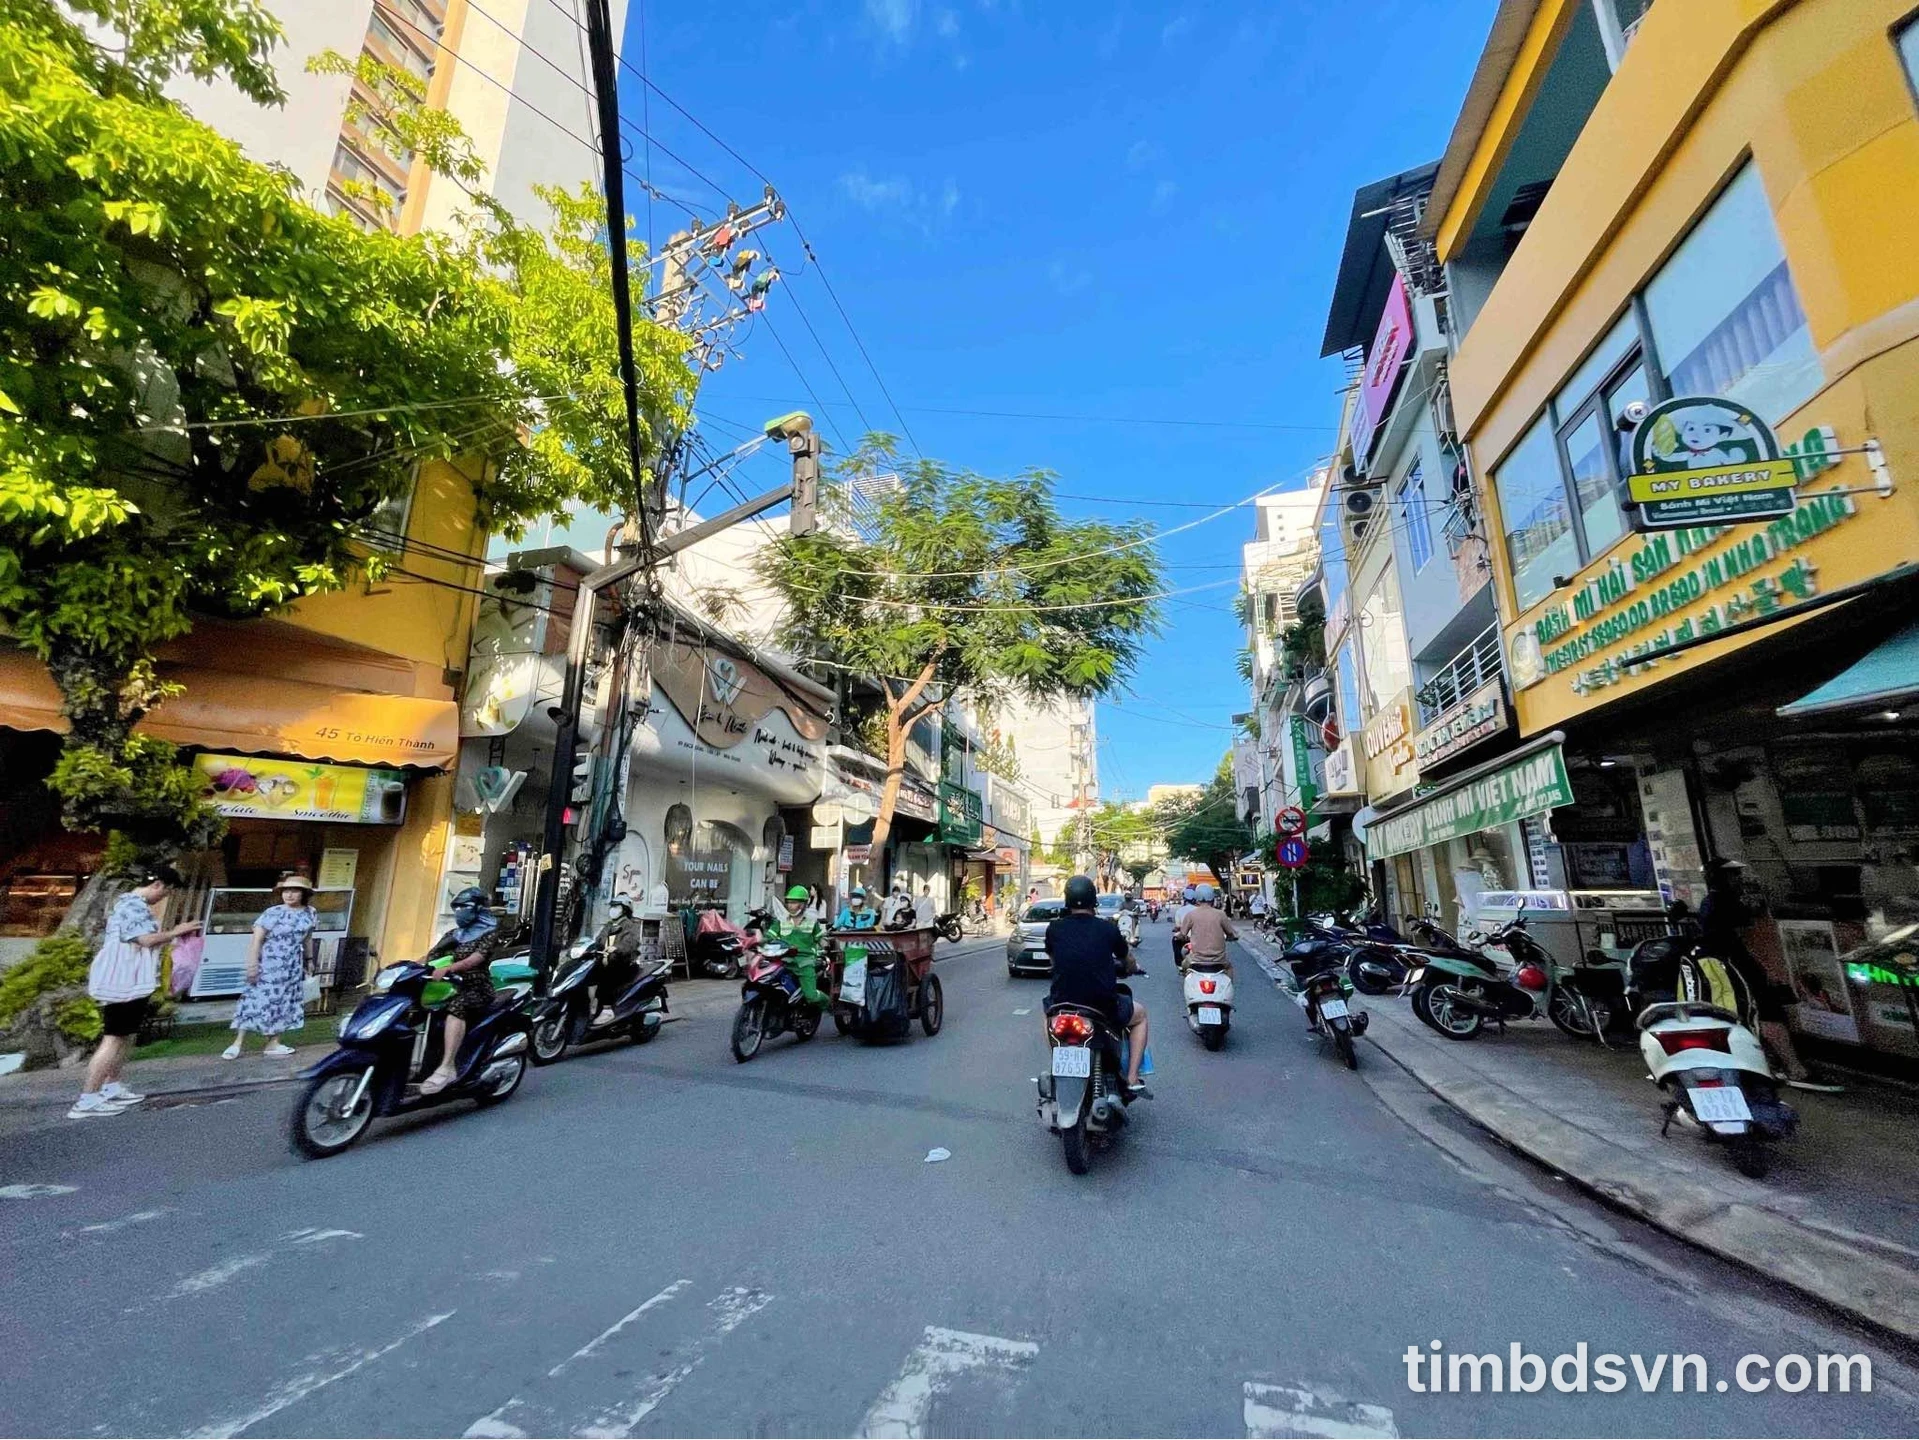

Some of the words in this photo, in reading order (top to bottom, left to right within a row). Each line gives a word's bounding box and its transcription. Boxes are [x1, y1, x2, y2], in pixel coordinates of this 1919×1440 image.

[1651, 480, 1680, 493] MY
[1688, 470, 1771, 489] BAKERY
[1597, 557, 1628, 608] HẢI
[315, 727, 342, 740] 45
[399, 737, 436, 751] Thành
[1366, 705, 1405, 761] OUVENIR
[1511, 752, 1558, 800] NAM
[292, 808, 352, 819] Smoothie
[684, 861, 704, 872] YOUR
[707, 862, 728, 872] NAILS
[690, 878, 707, 889] CAN
[709, 879, 719, 889] BE
